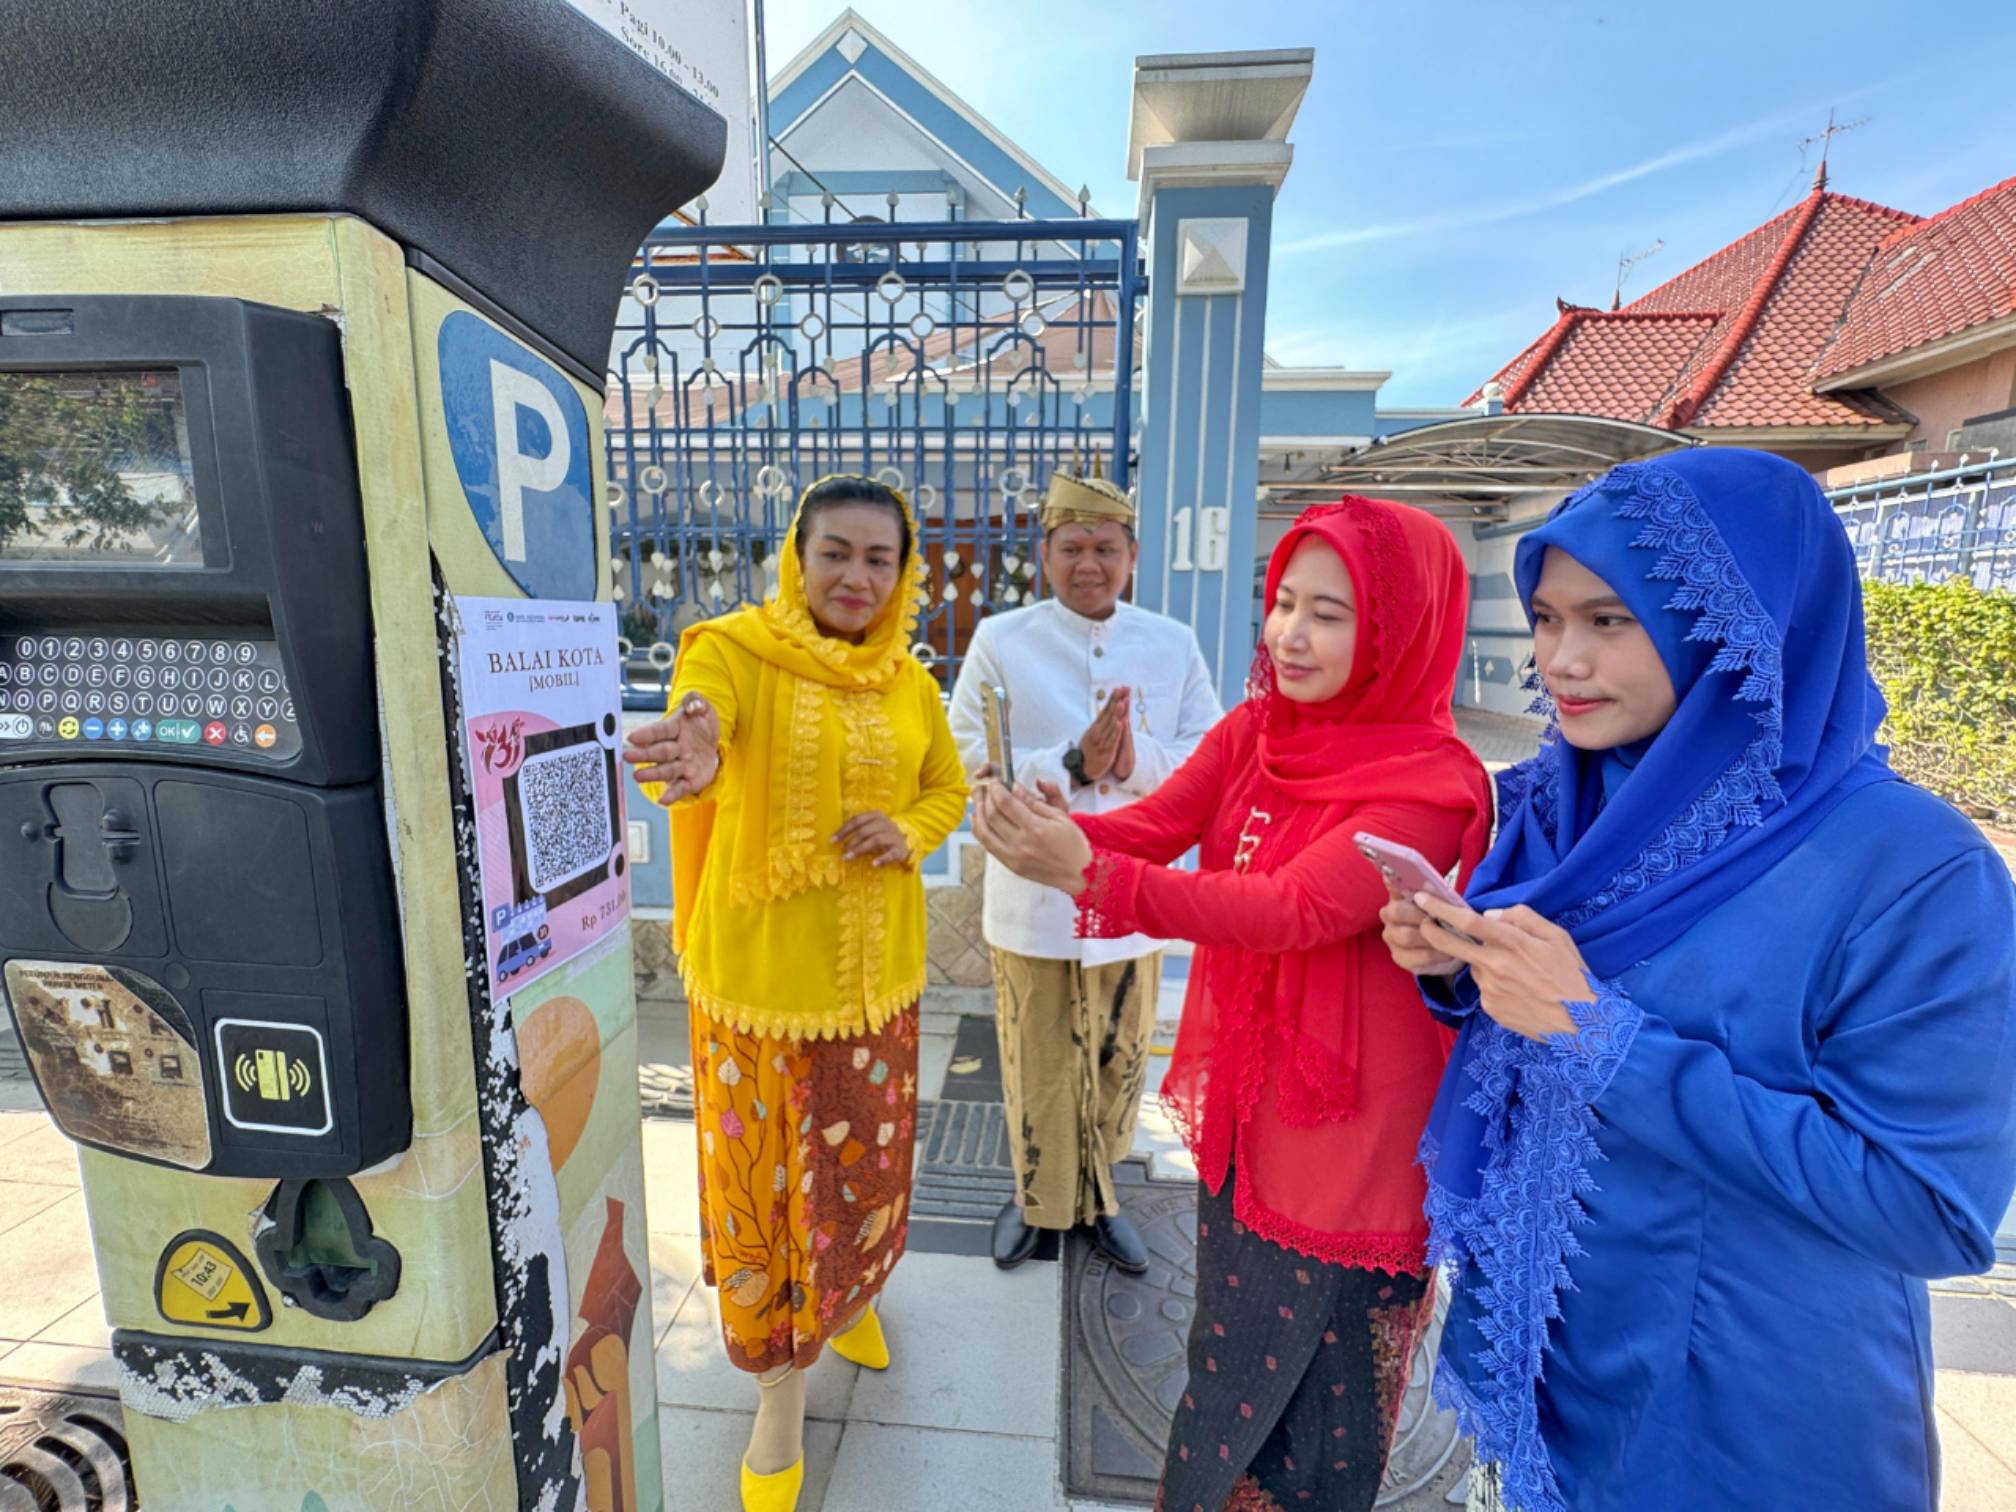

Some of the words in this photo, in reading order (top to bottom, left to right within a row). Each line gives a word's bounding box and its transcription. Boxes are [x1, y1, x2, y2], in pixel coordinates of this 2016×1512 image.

[490, 357, 570, 563] P
[1171, 506, 1227, 571] 16
[22, 641, 29, 655] 0
[45, 641, 53, 656] 1
[70, 642, 79, 656] 2
[94, 642, 103, 657] 3
[117, 643, 128, 657] 4
[142, 644, 152, 658] 5
[166, 644, 175, 659] 6
[190, 645, 200, 659] 7
[215, 645, 225, 660] 8
[241, 646, 251, 661] 9
[488, 650, 552, 673] BALAI
[558, 647, 604, 667] KOTA
[20, 667, 30, 680] B
[43, 668, 54, 681] C
[69, 668, 79, 681] D
[92, 669, 101, 681] E
[116, 670, 125, 683] F
[138, 670, 150, 684] G
[164, 671, 175, 685] H
[192, 672, 196, 685] I
[214, 672, 222, 686] J
[239, 674, 249, 687] K
[265, 675, 274, 689] L
[17, 694, 29, 707] O
[43, 694, 52, 708] P
[65, 695, 78, 709] Q
[89, 695, 100, 709] R
[113, 696, 124, 709] S
[138, 696, 149, 711] T
[163, 698, 174, 711] U
[187, 699, 198, 712] V
[209, 699, 224, 713] W
[236, 701, 247, 714] X
[262, 702, 273, 716] Y
[160, 727, 175, 736] OK
[496, 910, 506, 927] P
[581, 915, 597, 931] Rp
[191, 1260, 217, 1287] 10:43
